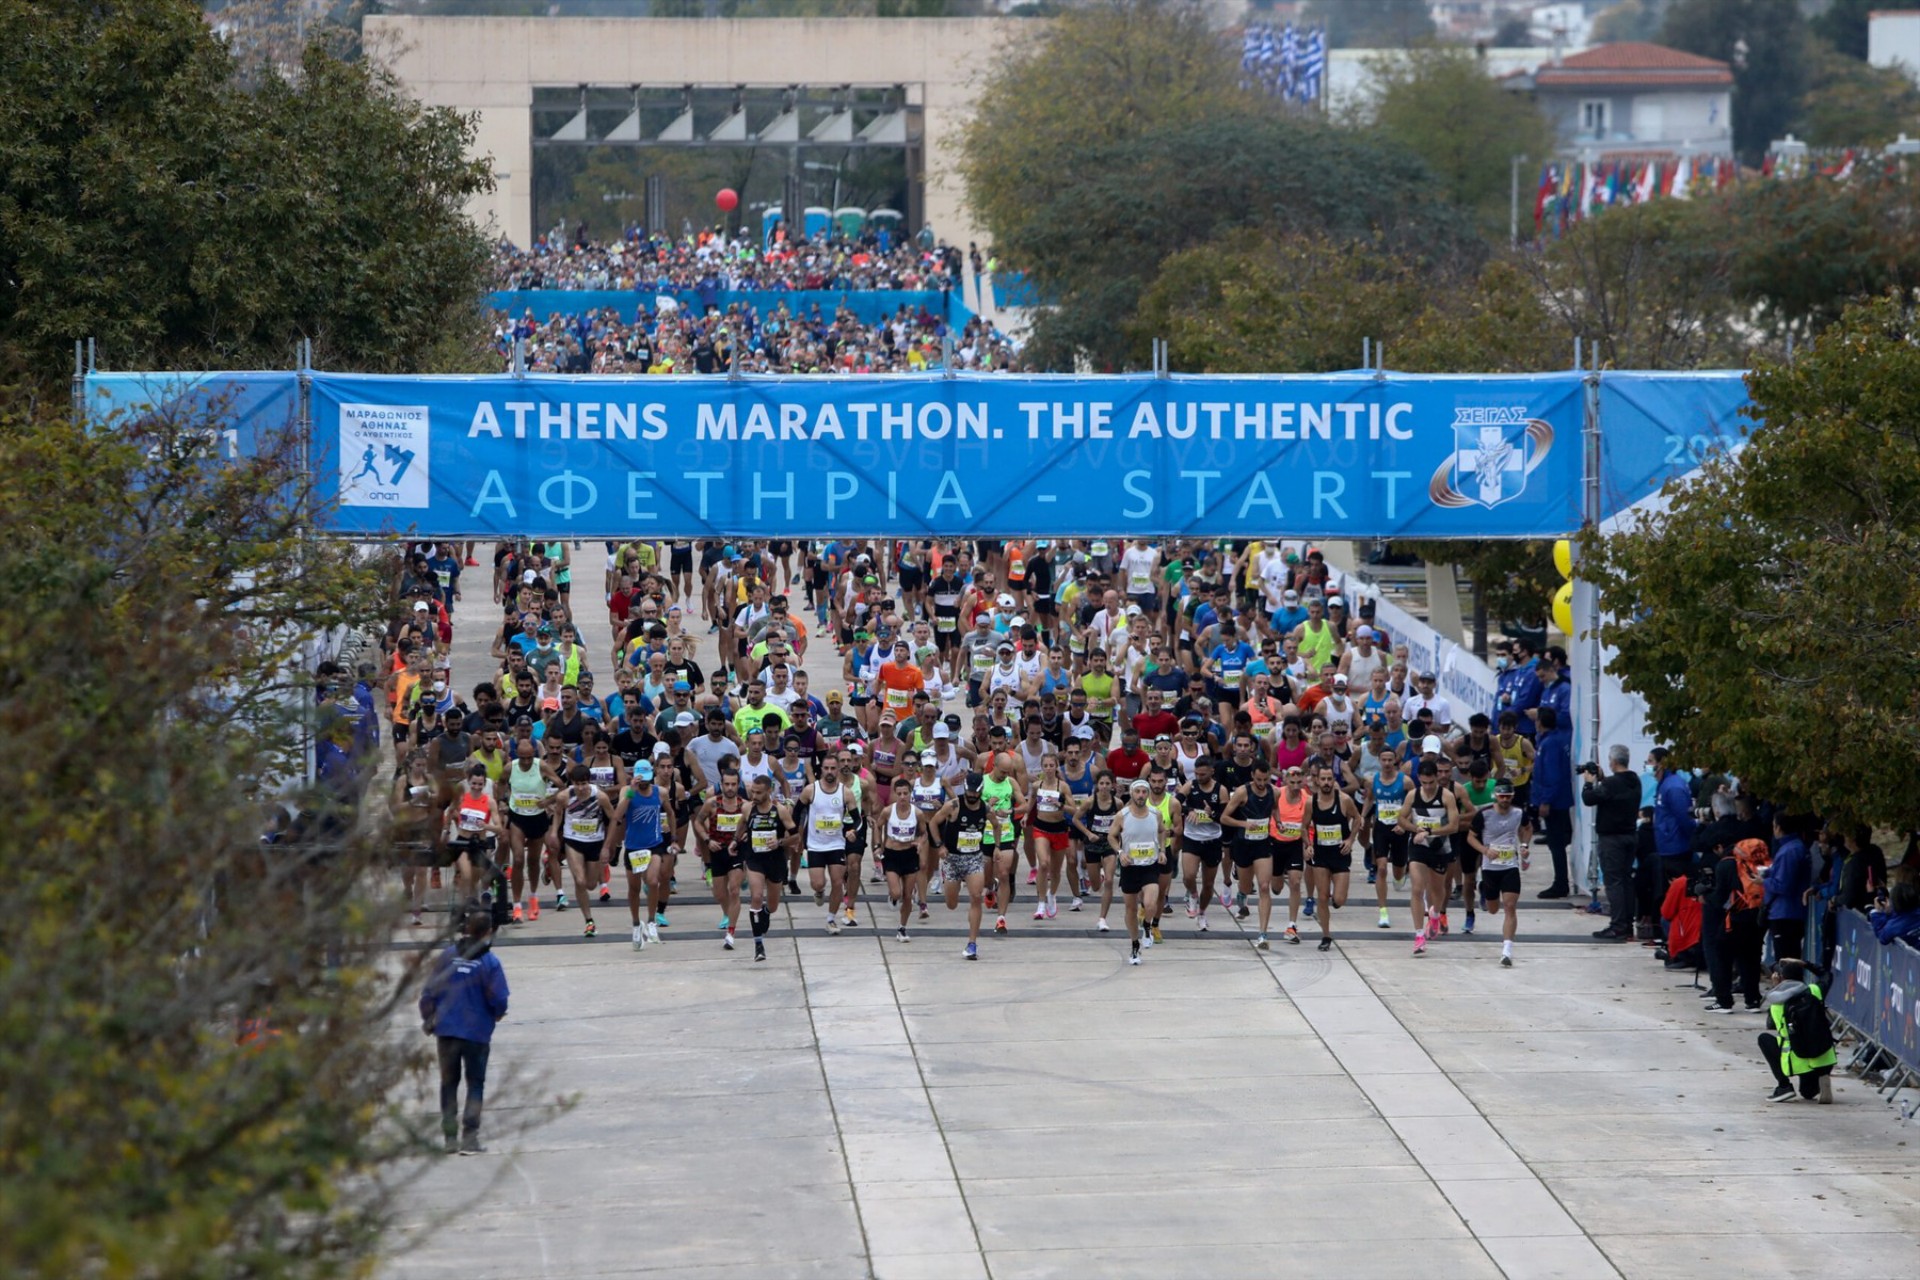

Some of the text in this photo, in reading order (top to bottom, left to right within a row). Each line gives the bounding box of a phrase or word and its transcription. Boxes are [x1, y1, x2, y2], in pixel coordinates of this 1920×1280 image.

[346, 410, 423, 421] ΜΑΡΑΘΩΝΙΟΣ
[468, 401, 1413, 441] ATHENS MARATHON. THE AUTHENTIC
[1454, 406, 1528, 423] ΣΕΓΑΣ
[361, 421, 408, 431] ΑΘΗΝΑΣ
[362, 431, 413, 439] ΑΥΘΕΝΤΙΚΟΣ
[470, 470, 972, 520] ΑΦΕΤΗΡΙΑ
[1122, 470, 1411, 520] START
